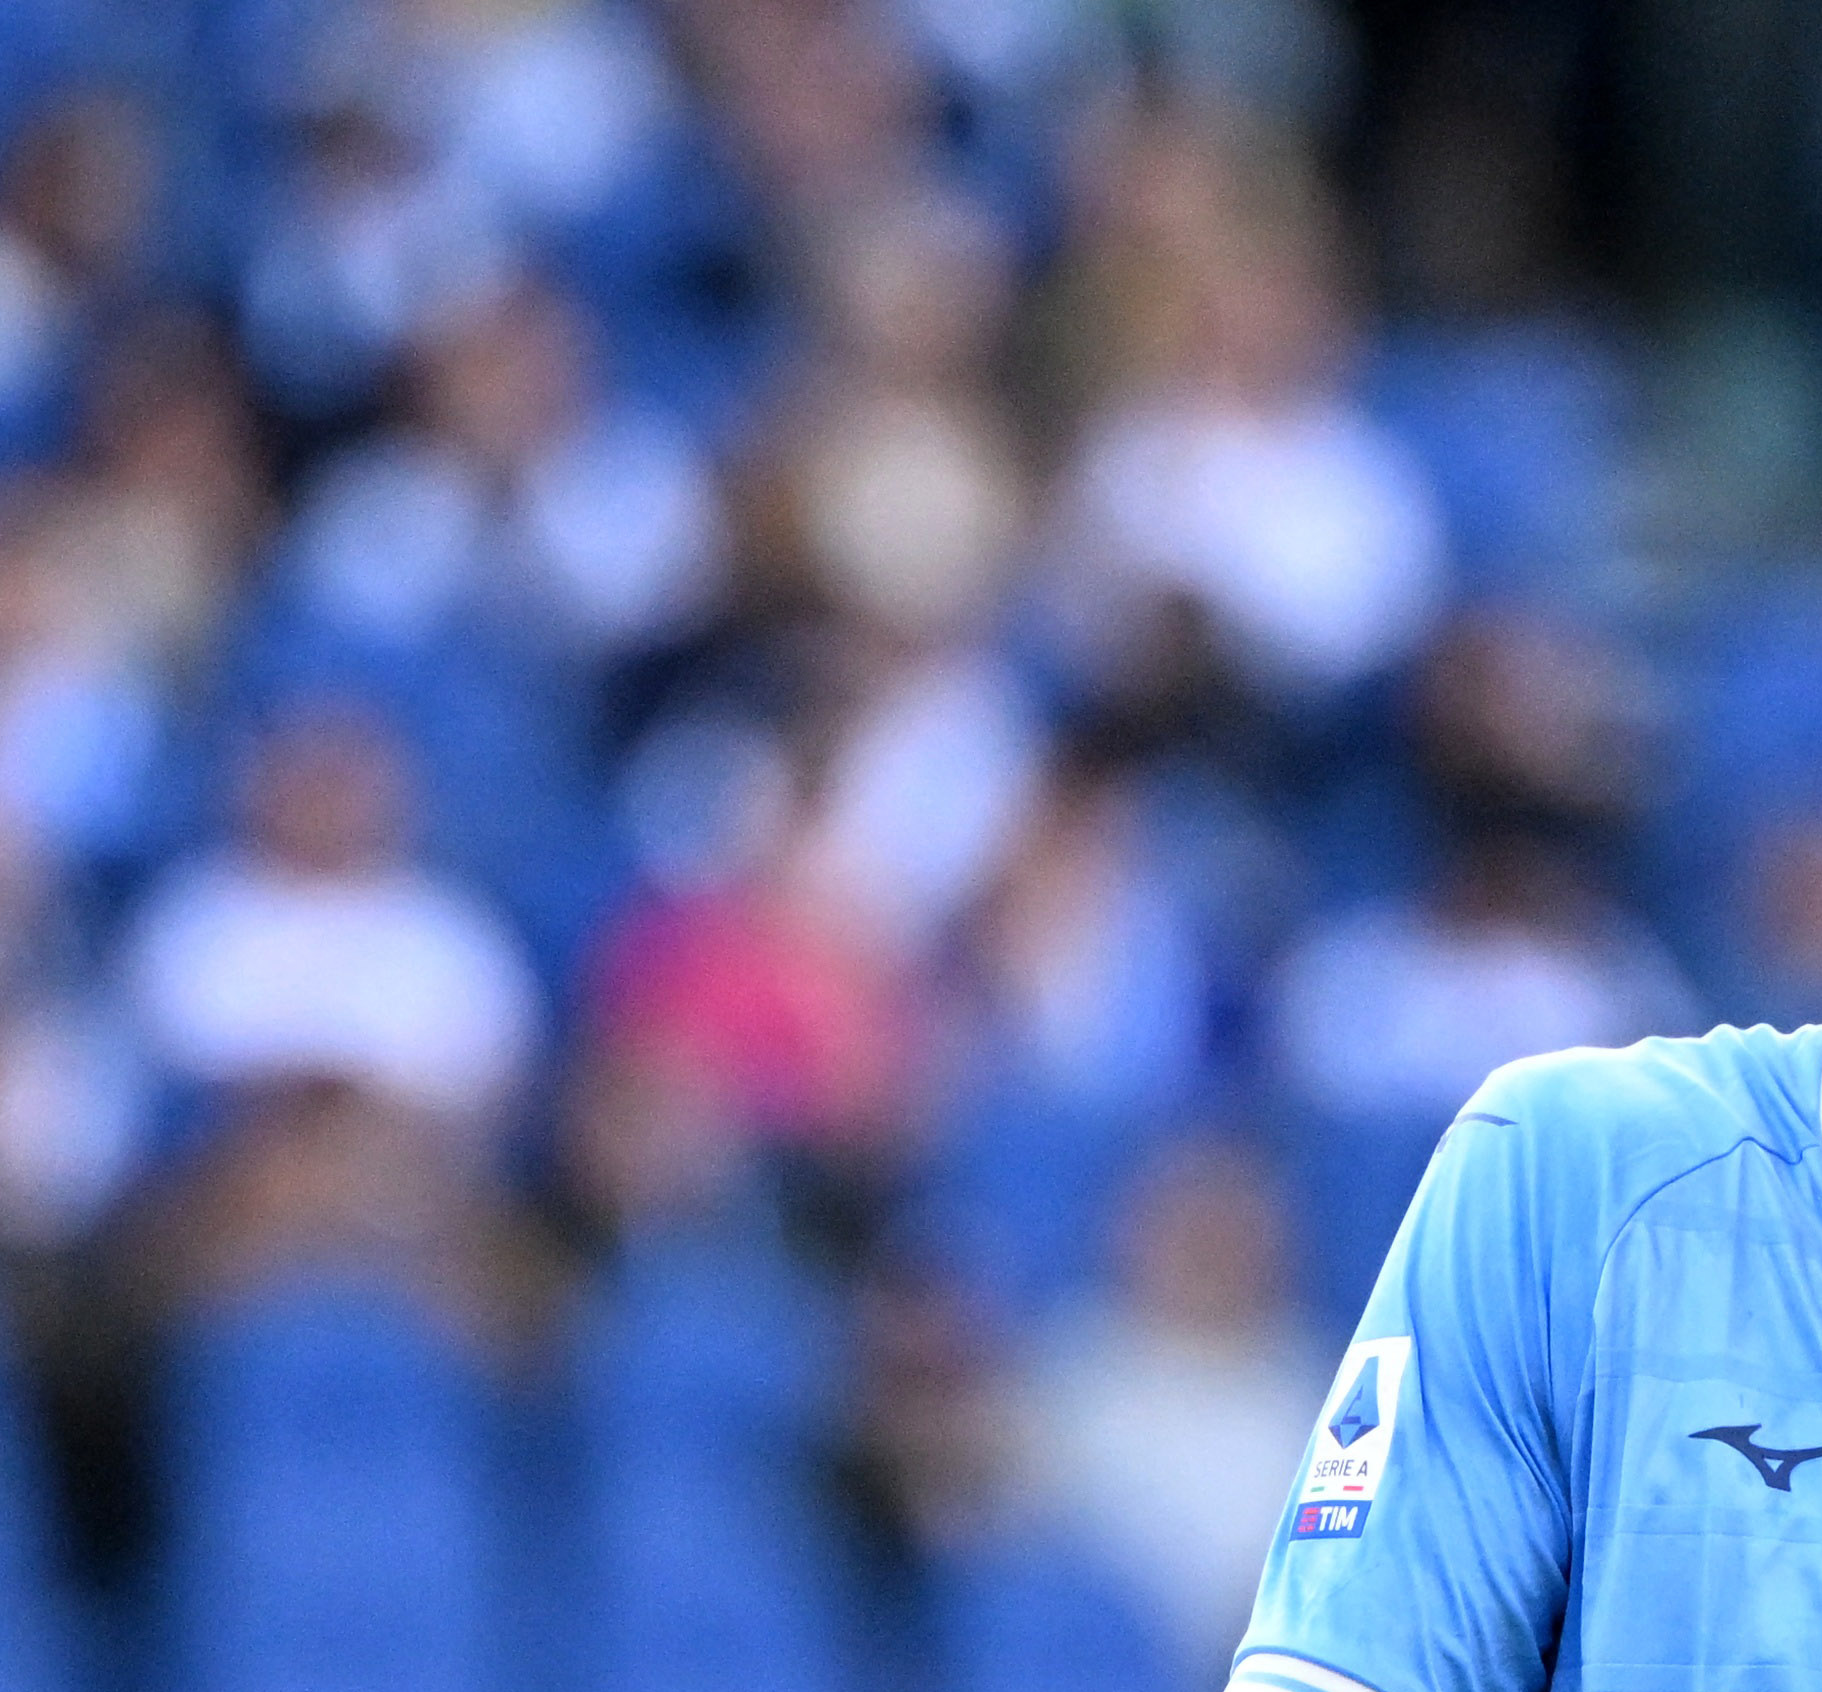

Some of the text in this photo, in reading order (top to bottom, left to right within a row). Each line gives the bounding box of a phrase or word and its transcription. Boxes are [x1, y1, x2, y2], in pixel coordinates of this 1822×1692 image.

[1315, 1459, 1369, 1478] SERIE A
[1319, 1506, 1358, 1532] TIM
